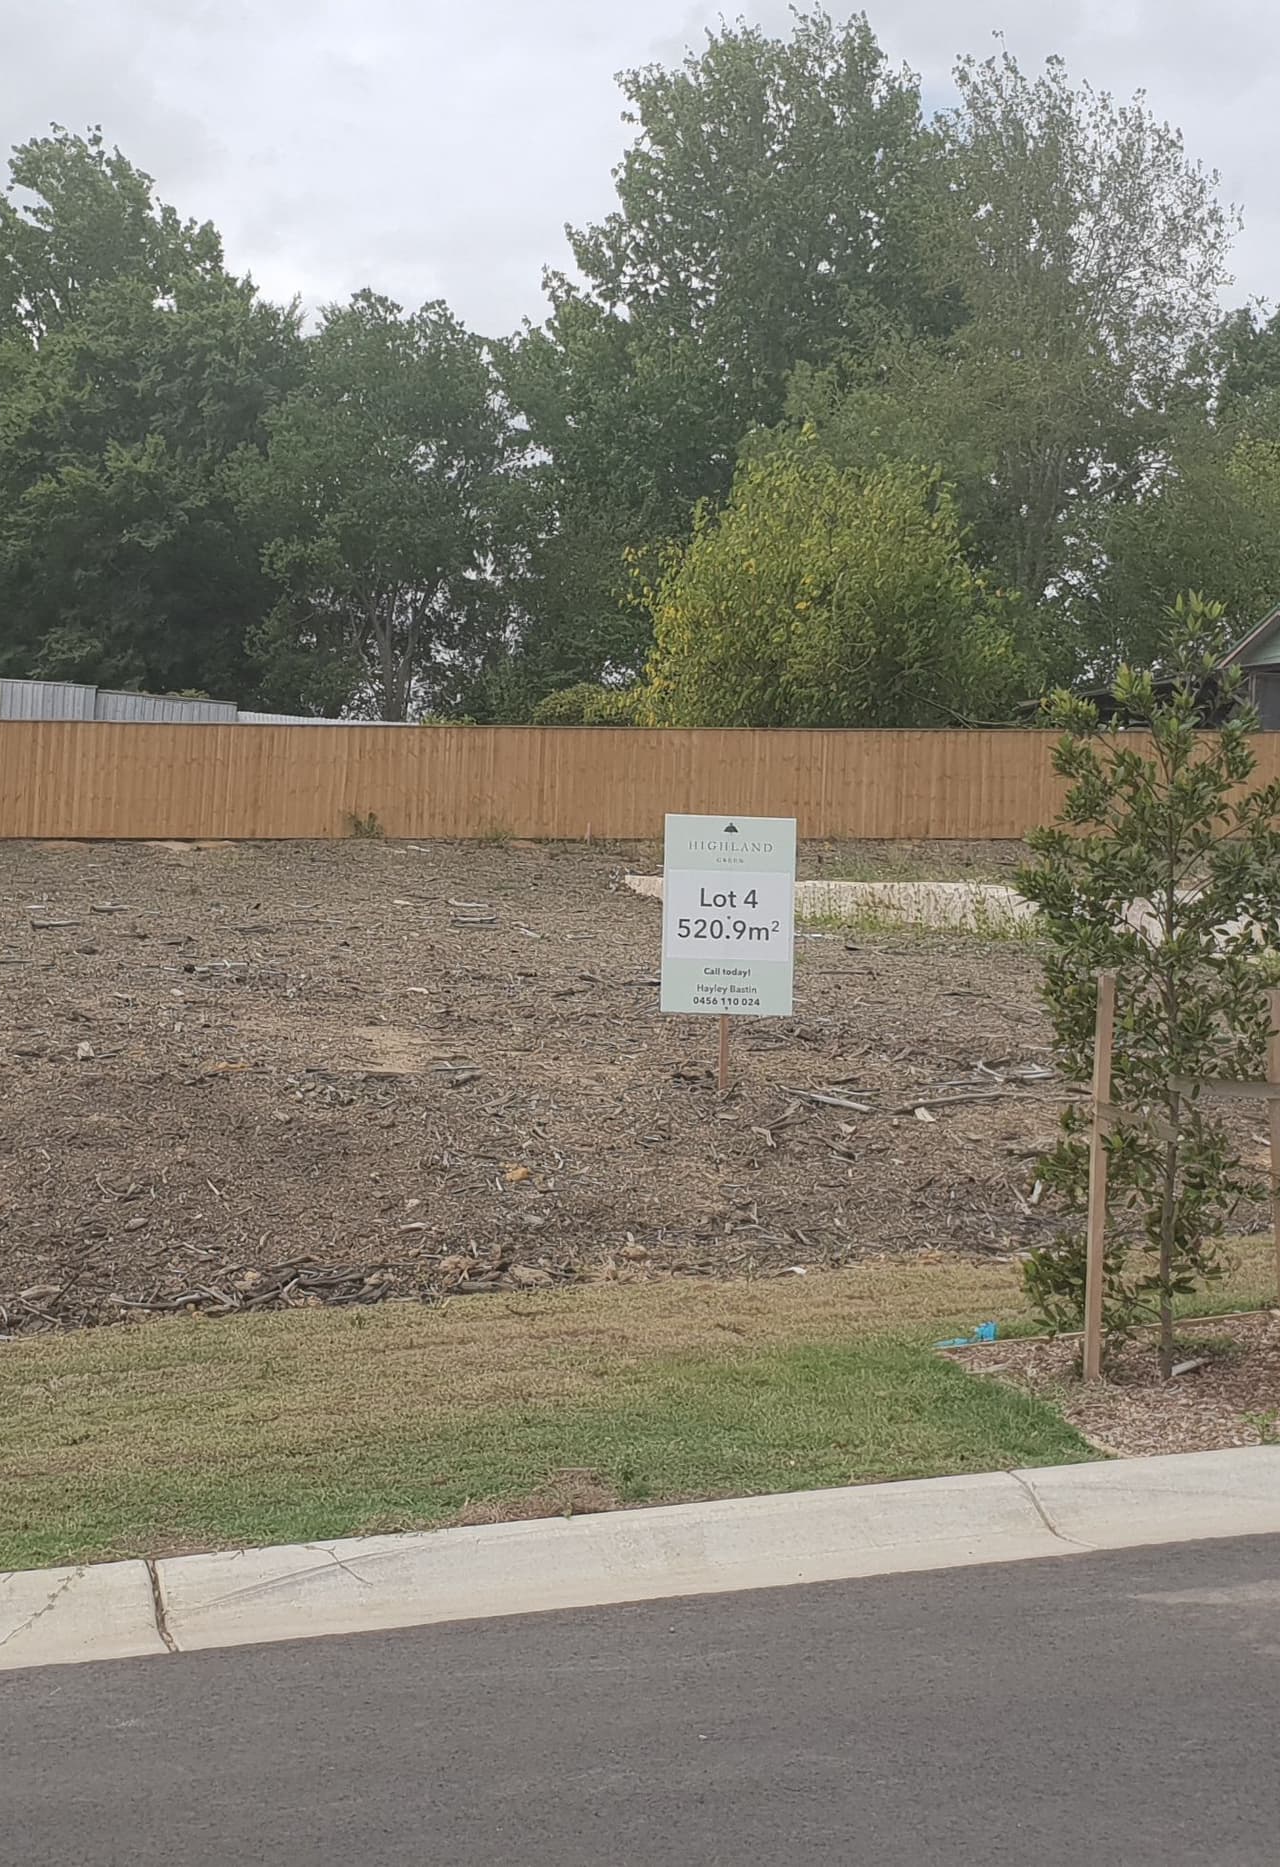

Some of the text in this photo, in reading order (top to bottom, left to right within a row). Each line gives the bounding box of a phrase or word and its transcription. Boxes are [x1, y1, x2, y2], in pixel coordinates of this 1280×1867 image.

[688, 840, 774, 853] HIGHLAND
[700, 887, 758, 909] Lot 4
[703, 967, 751, 978] Call today!
[696, 984, 757, 994] Hayley Bastin
[693, 996, 760, 1007] 0456 110 024
